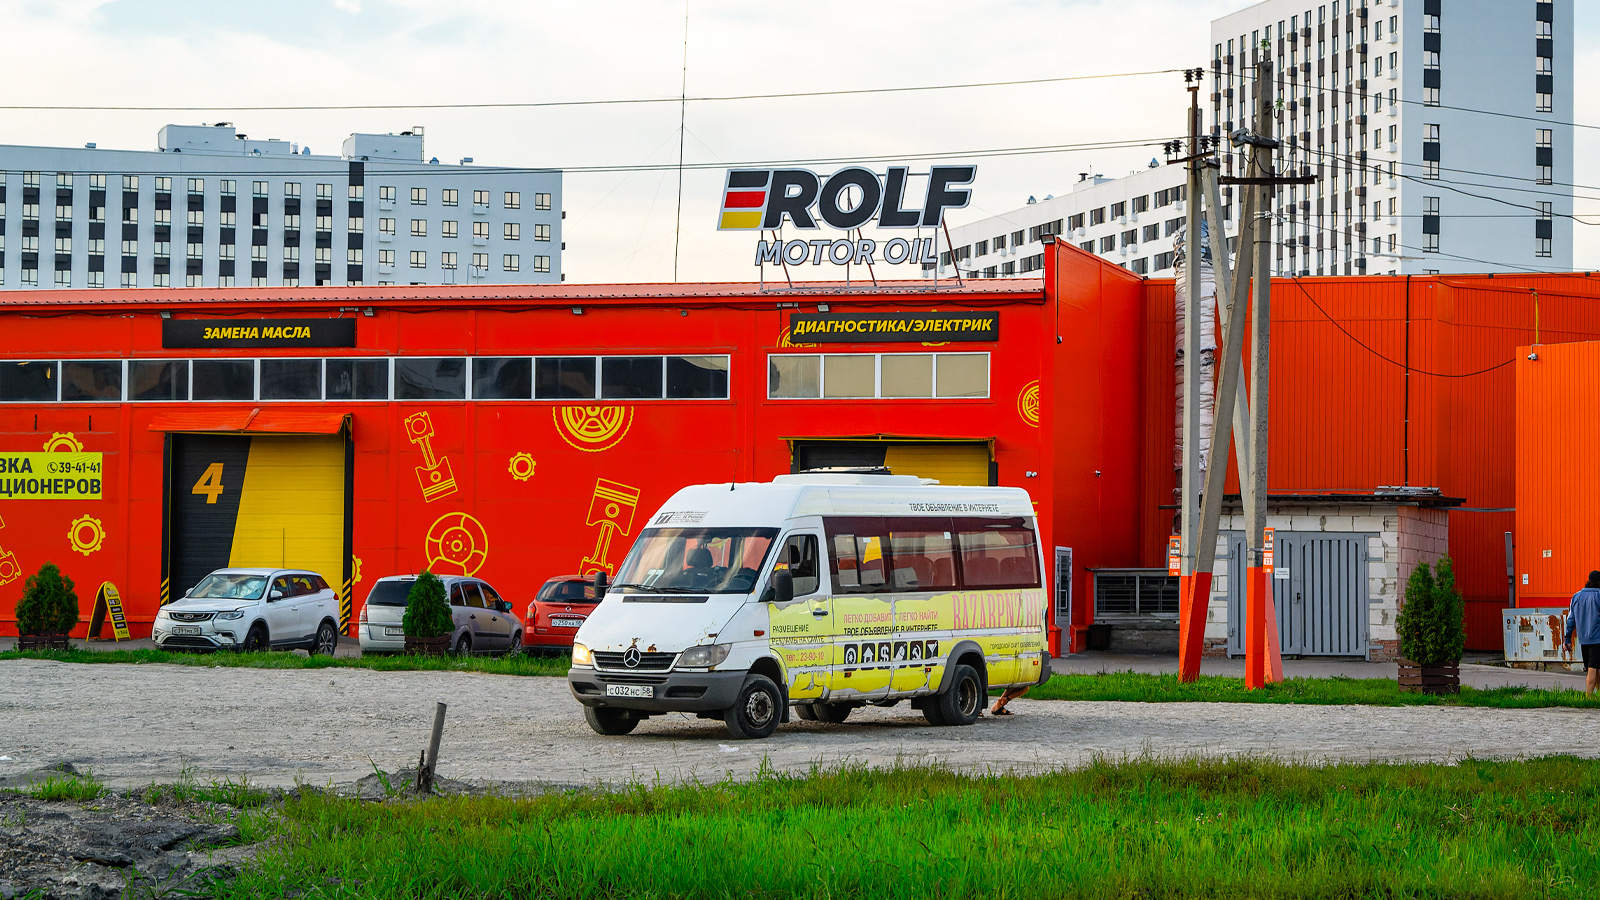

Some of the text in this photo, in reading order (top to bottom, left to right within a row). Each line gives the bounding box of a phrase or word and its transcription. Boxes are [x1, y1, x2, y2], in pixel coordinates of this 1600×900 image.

[760, 164, 978, 231] ROLF
[755, 237, 939, 267] MOTOR OIL
[203, 326, 311, 339] ЗАМЕНА МАСЛА
[793, 318, 994, 335] ДИАГНОСТИКА/ЭЛЕКТРИК
[58, 462, 101, 473] 39-41-41
[191, 462, 225, 504] 4
[843, 614, 863, 624] ЛЕГКО
[919, 610, 938, 621] НАЙТИ
[772, 624, 809, 634] РАЗМЕЩЕНИЕ
